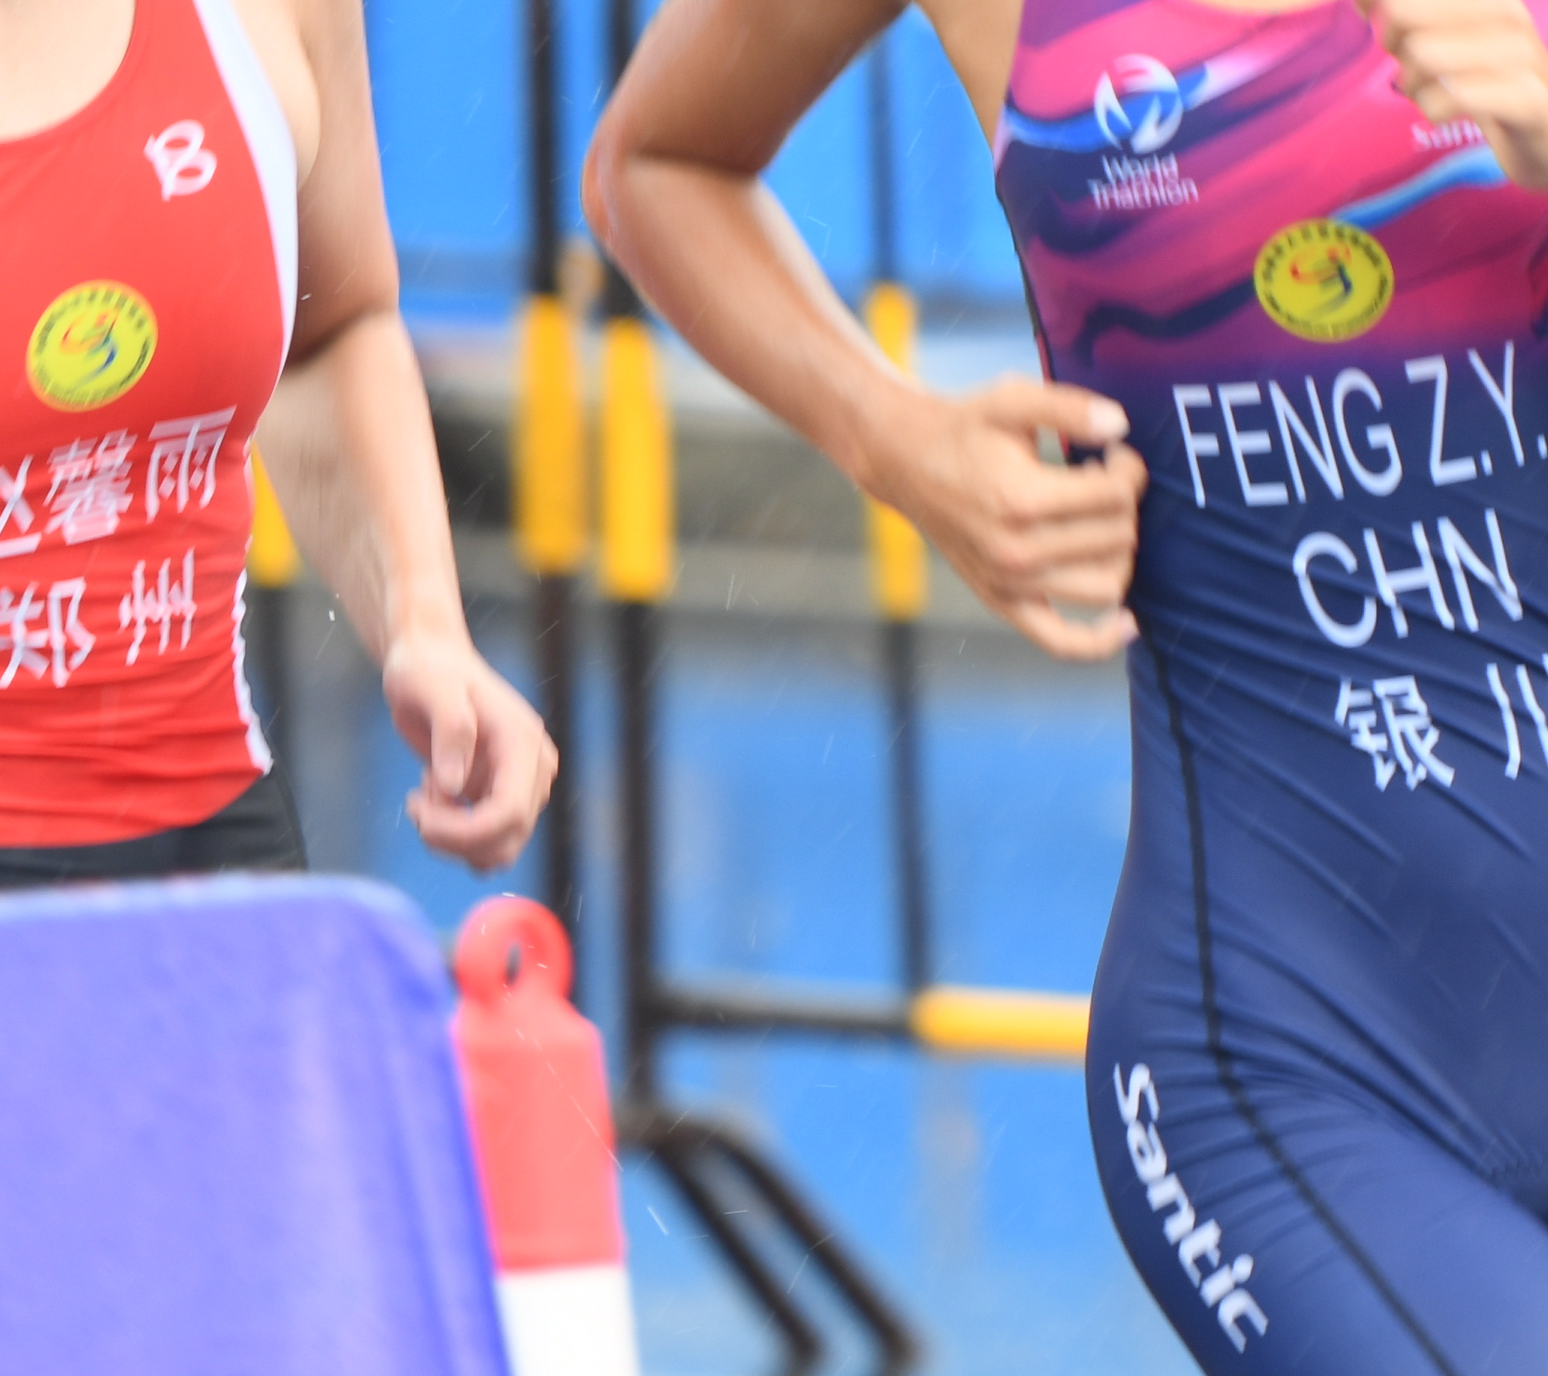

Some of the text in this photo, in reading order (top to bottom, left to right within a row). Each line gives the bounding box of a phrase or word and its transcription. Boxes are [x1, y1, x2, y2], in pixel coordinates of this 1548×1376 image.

[1086, 175, 1200, 211] Triathlon
[1101, 151, 1180, 186] World
[1172, 341, 1548, 509] FENG Z.Y.
[1292, 509, 1523, 649] CHN
[1113, 1061, 1270, 1355] Santic
